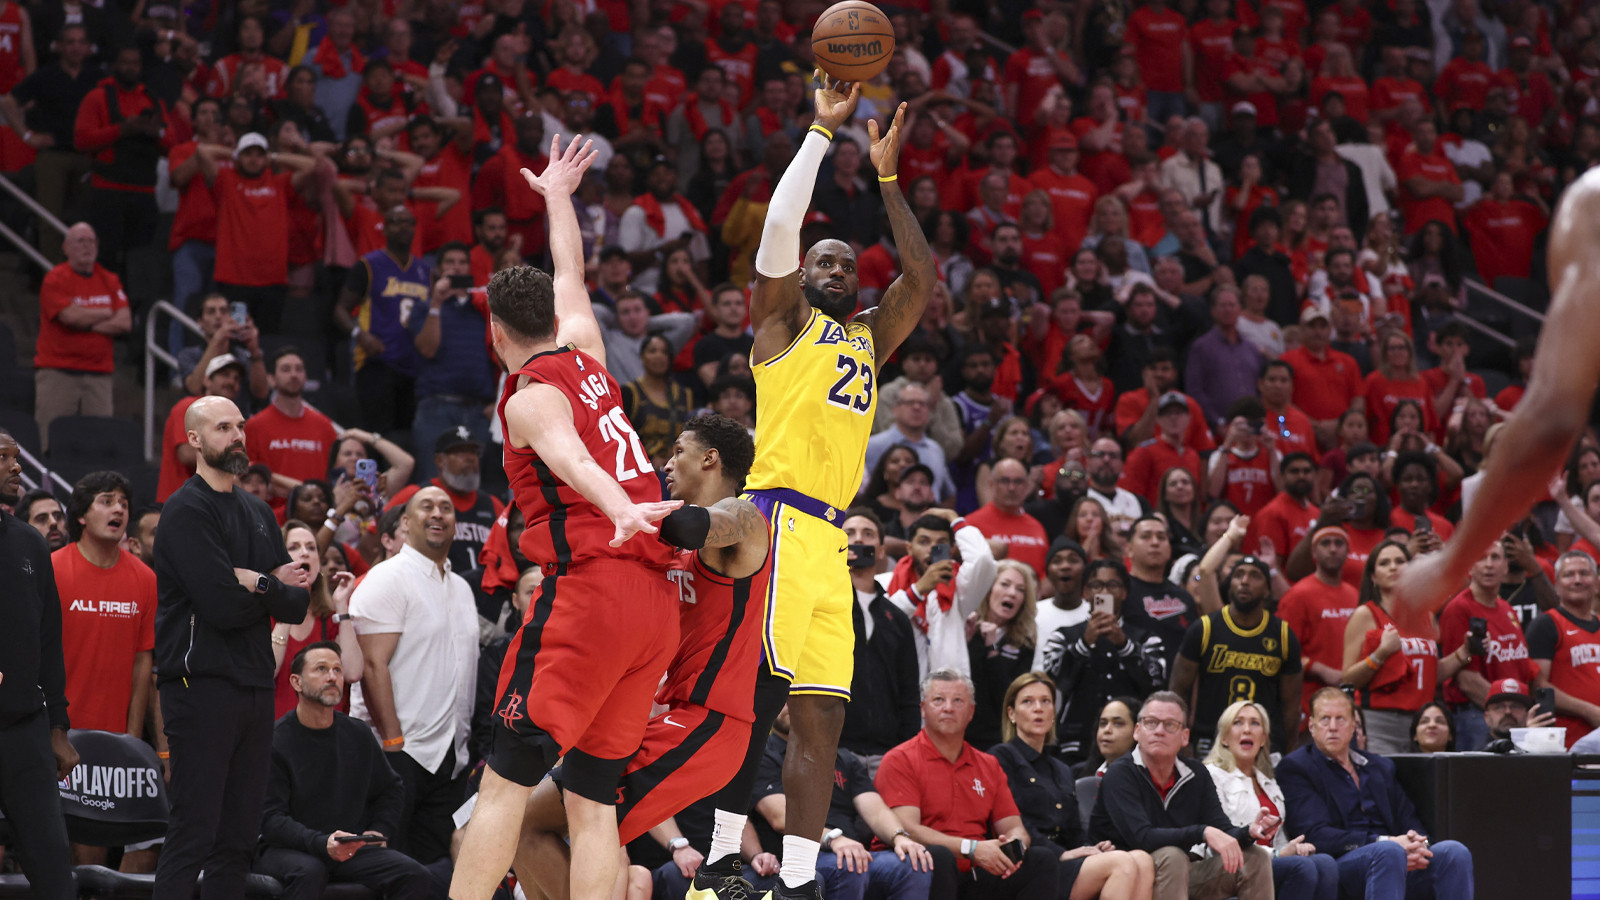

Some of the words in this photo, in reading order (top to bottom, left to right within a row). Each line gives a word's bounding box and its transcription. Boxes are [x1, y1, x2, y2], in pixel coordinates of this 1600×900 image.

[828, 40, 883, 58] Wilson
[826, 353, 874, 416] 23
[269, 439, 290, 449] ALL
[454, 522, 489, 543] USTO
[69, 599, 97, 612] ALL
[99, 601, 131, 614] FIRE
[1207, 644, 1282, 677] LEGEND
[1412, 658, 1424, 690] 7
[71, 763, 158, 799] PLAYOFFS
[81, 794, 115, 811] Google
